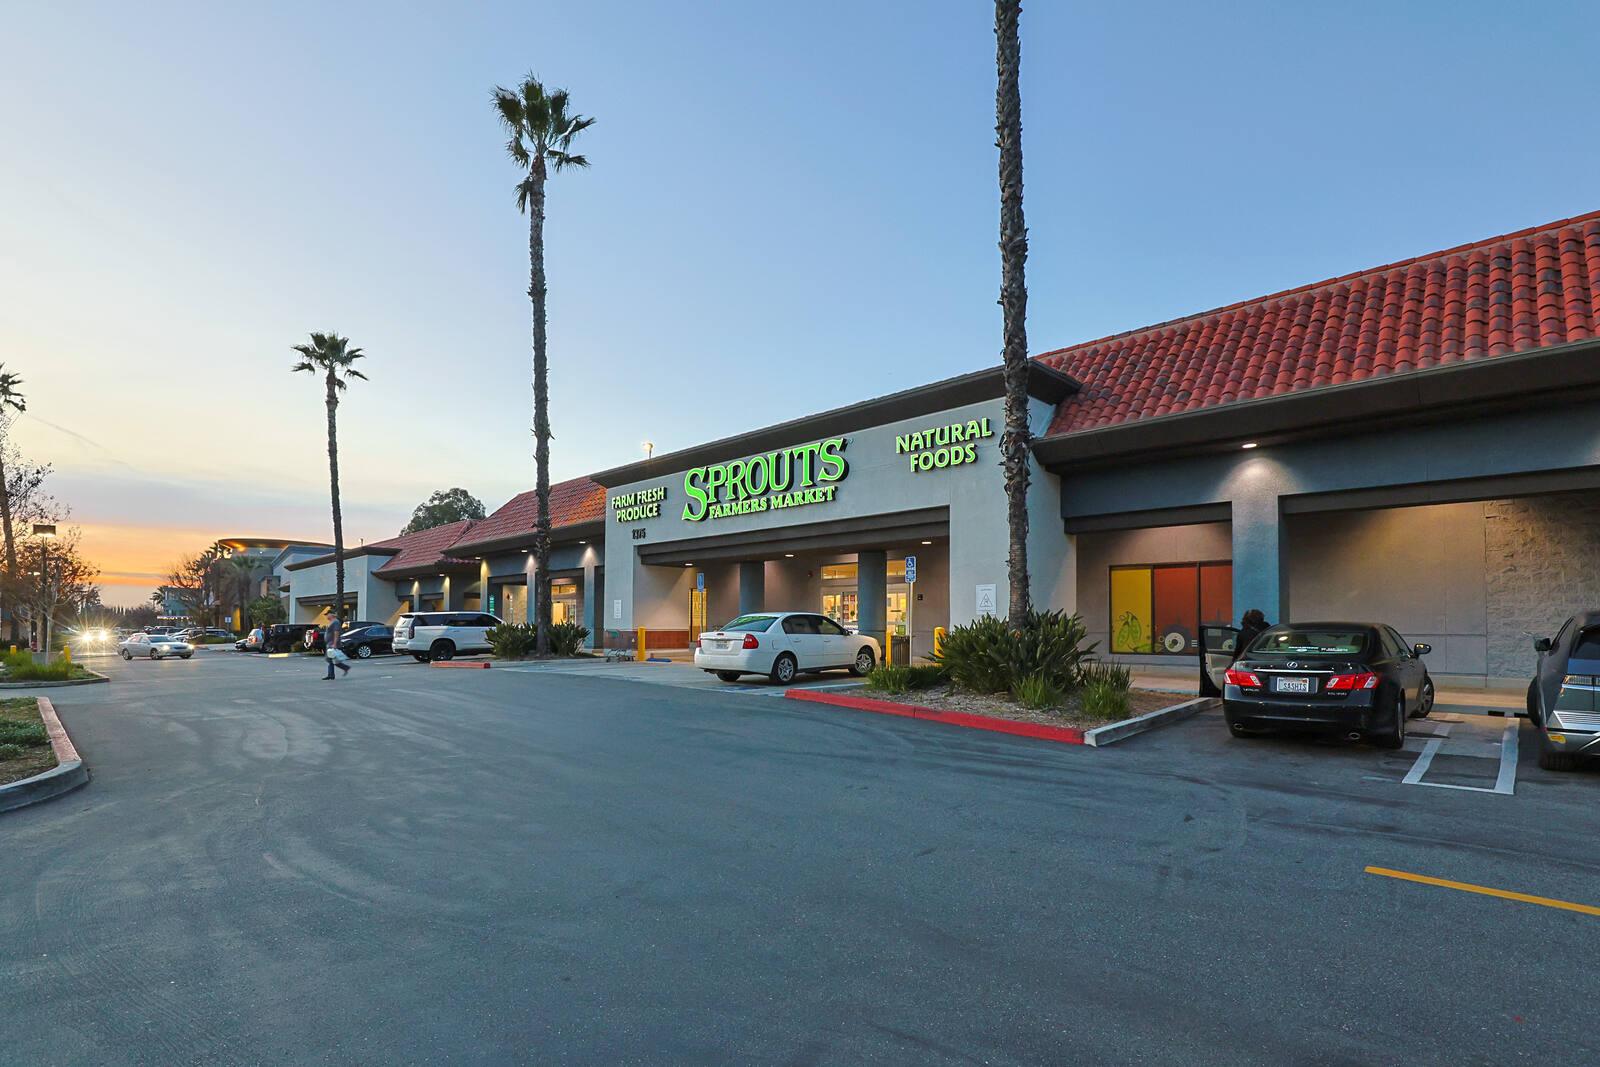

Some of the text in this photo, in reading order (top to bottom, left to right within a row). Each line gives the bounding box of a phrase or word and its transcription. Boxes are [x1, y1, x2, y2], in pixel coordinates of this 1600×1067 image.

[896, 418, 992, 453] NATURAL
[910, 443, 976, 472] FOODS
[682, 438, 845, 521] SPROUTS
[611, 486, 665, 510] FARM FRESH
[616, 503, 658, 522] PRODUCE
[709, 486, 836, 519] FARMERS MARKET
